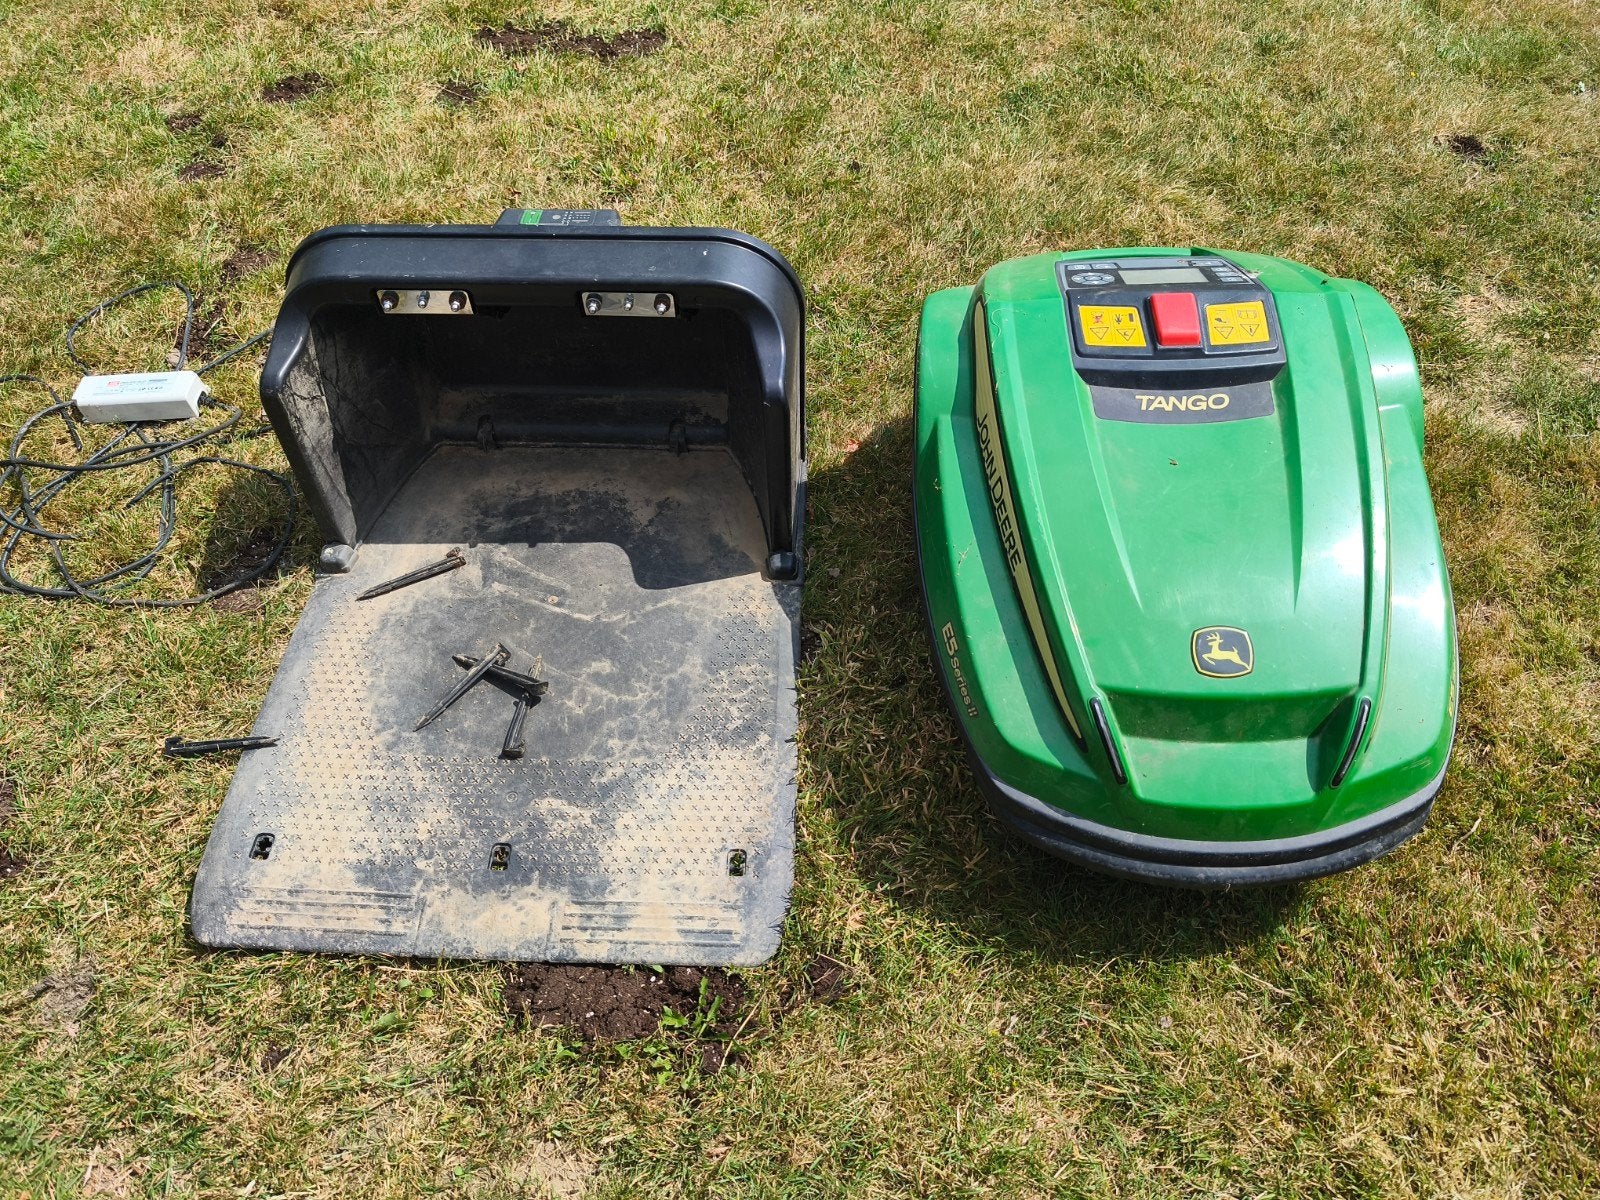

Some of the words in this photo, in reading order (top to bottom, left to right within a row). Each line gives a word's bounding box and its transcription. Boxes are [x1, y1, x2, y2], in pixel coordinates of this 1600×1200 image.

[1135, 393, 1230, 412] TANGO
[978, 413, 997, 481] JOHN
[991, 476, 1022, 571] DEERE
[950, 656, 972, 706] Series
